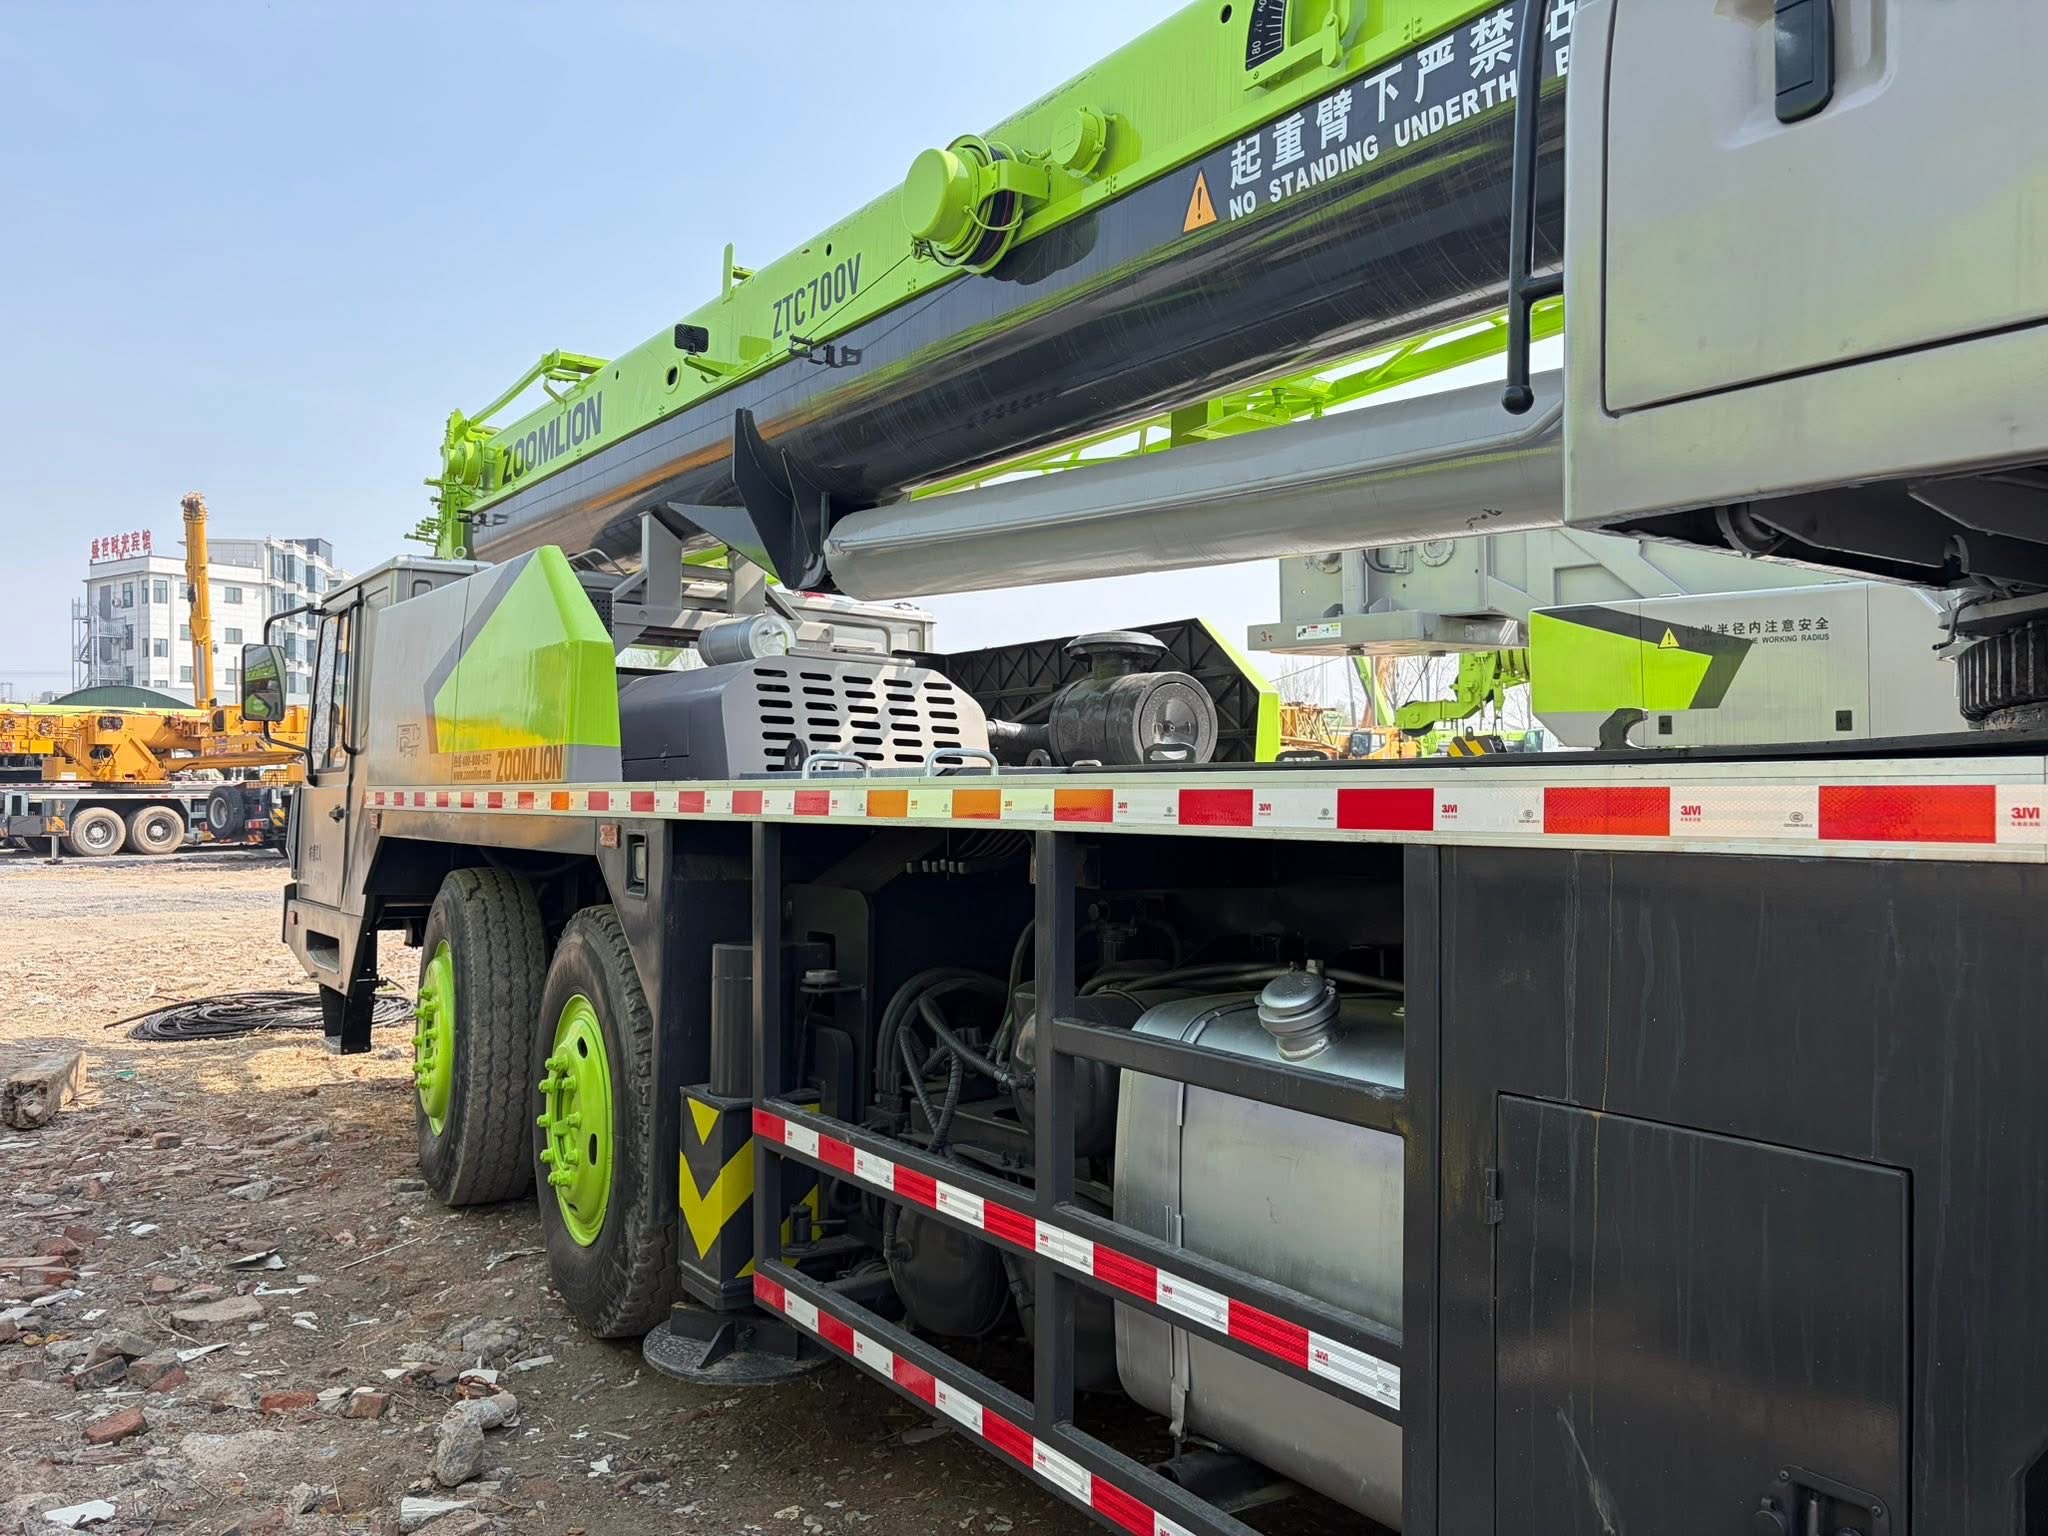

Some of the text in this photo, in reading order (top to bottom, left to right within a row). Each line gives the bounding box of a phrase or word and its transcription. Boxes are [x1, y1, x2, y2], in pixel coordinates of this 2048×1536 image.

[1251, 40, 1261, 55] 80
[1229, 68, 1519, 222] NO STANDING UNDERTH
[772, 252, 862, 339] ZTC700V
[502, 390, 602, 486] ZOOMLION
[1762, 635, 1798, 644] WORKING
[1801, 633, 1830, 642] RADIUS
[496, 744, 563, 783] ZOOMLION
[1258, 803, 1272, 812] 3M
[1441, 804, 1458, 814] 3M
[1680, 805, 1702, 816] 3M
[2011, 807, 2040, 819] 3M
[1315, 1349, 1329, 1362] 3M
